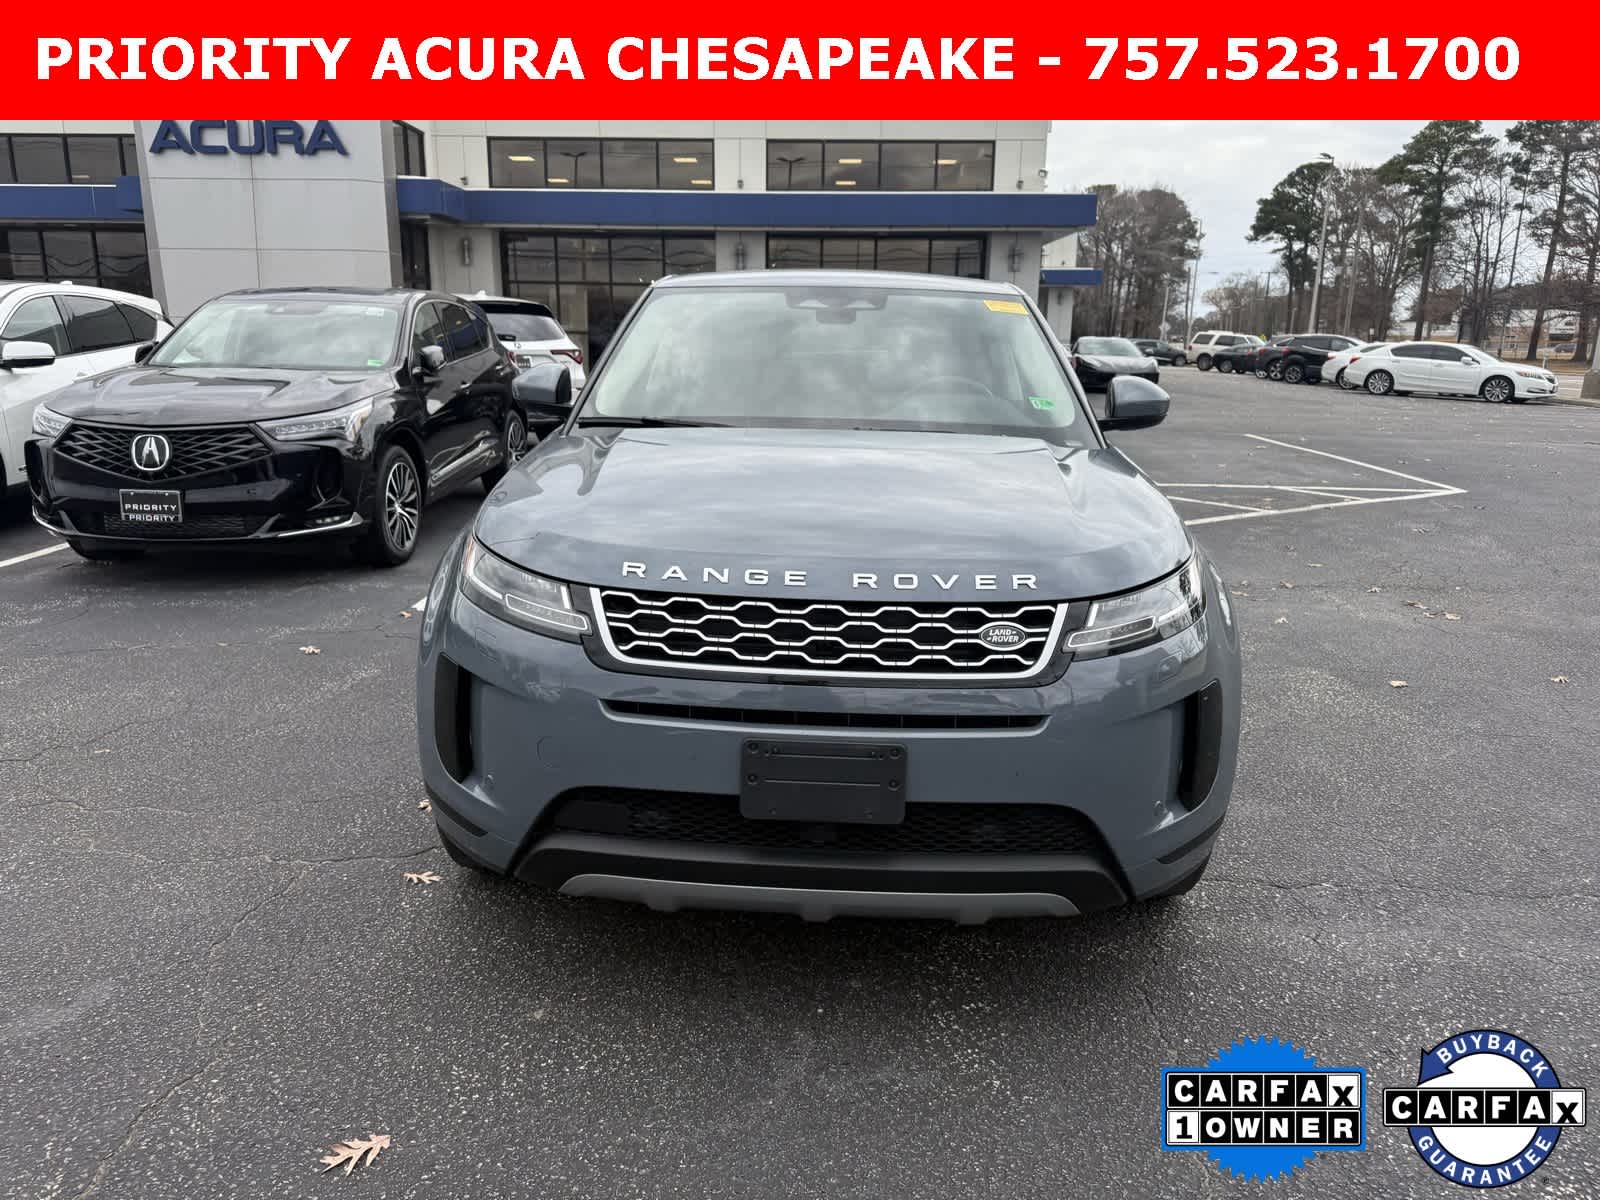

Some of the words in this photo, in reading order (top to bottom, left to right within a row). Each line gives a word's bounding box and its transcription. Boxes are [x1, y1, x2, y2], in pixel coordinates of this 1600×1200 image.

[150, 120, 349, 156] ACURA
[622, 561, 808, 586] RANGE
[852, 573, 1038, 590] ROVER
